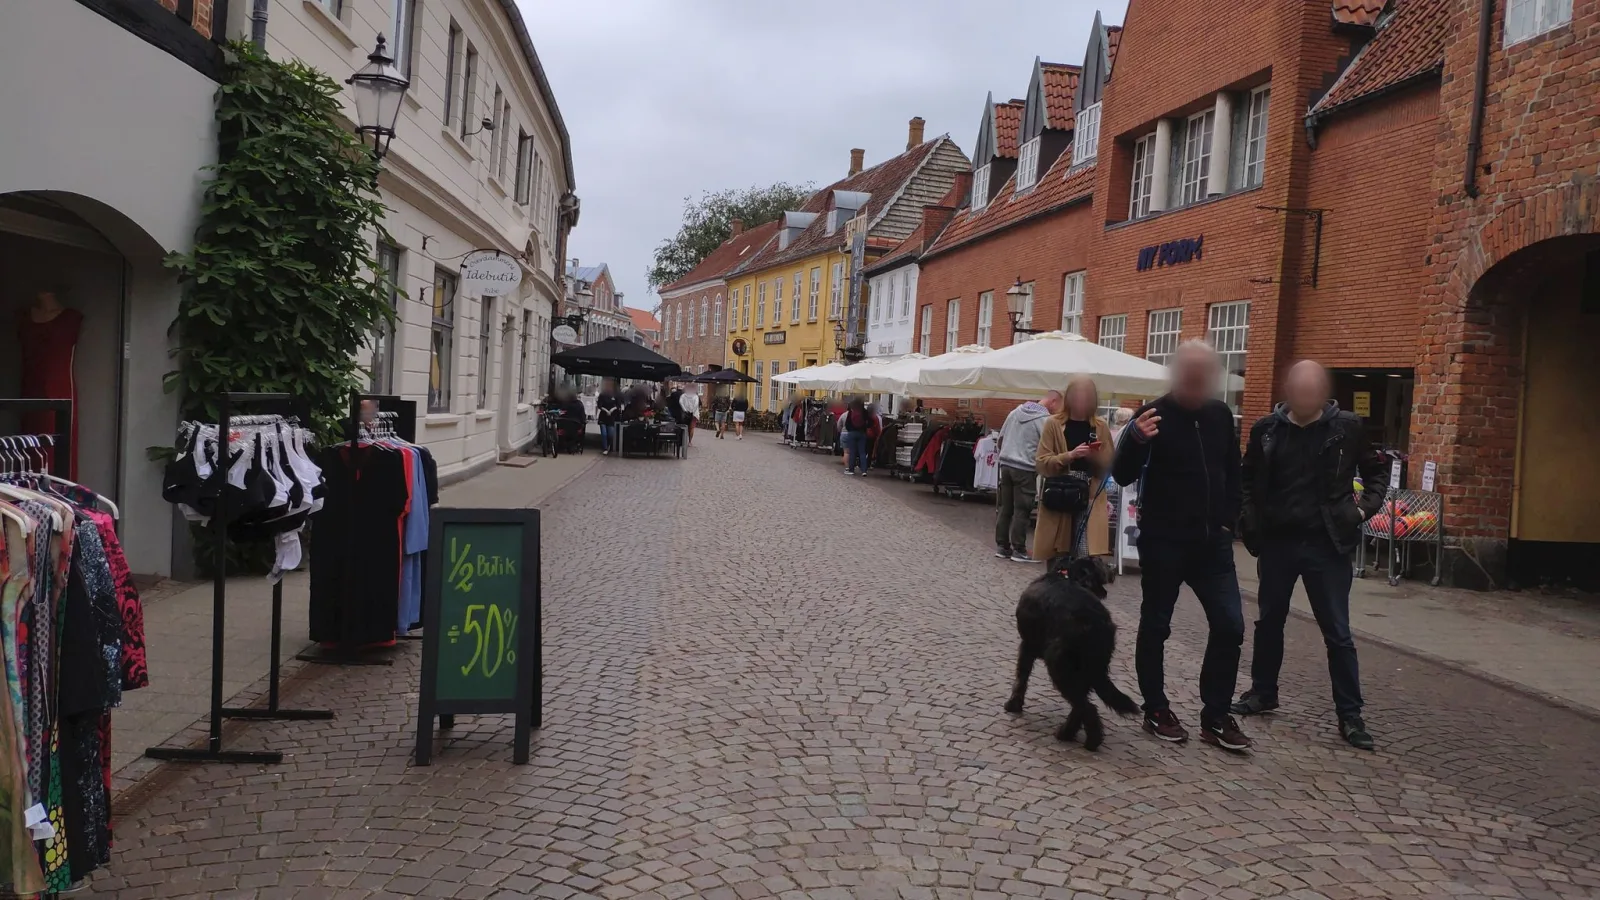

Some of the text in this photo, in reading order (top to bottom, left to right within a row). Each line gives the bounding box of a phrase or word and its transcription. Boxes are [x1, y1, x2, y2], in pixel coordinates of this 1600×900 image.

[1136, 233, 1204, 272] NY FORM
[466, 270, 519, 282] Idebutik
